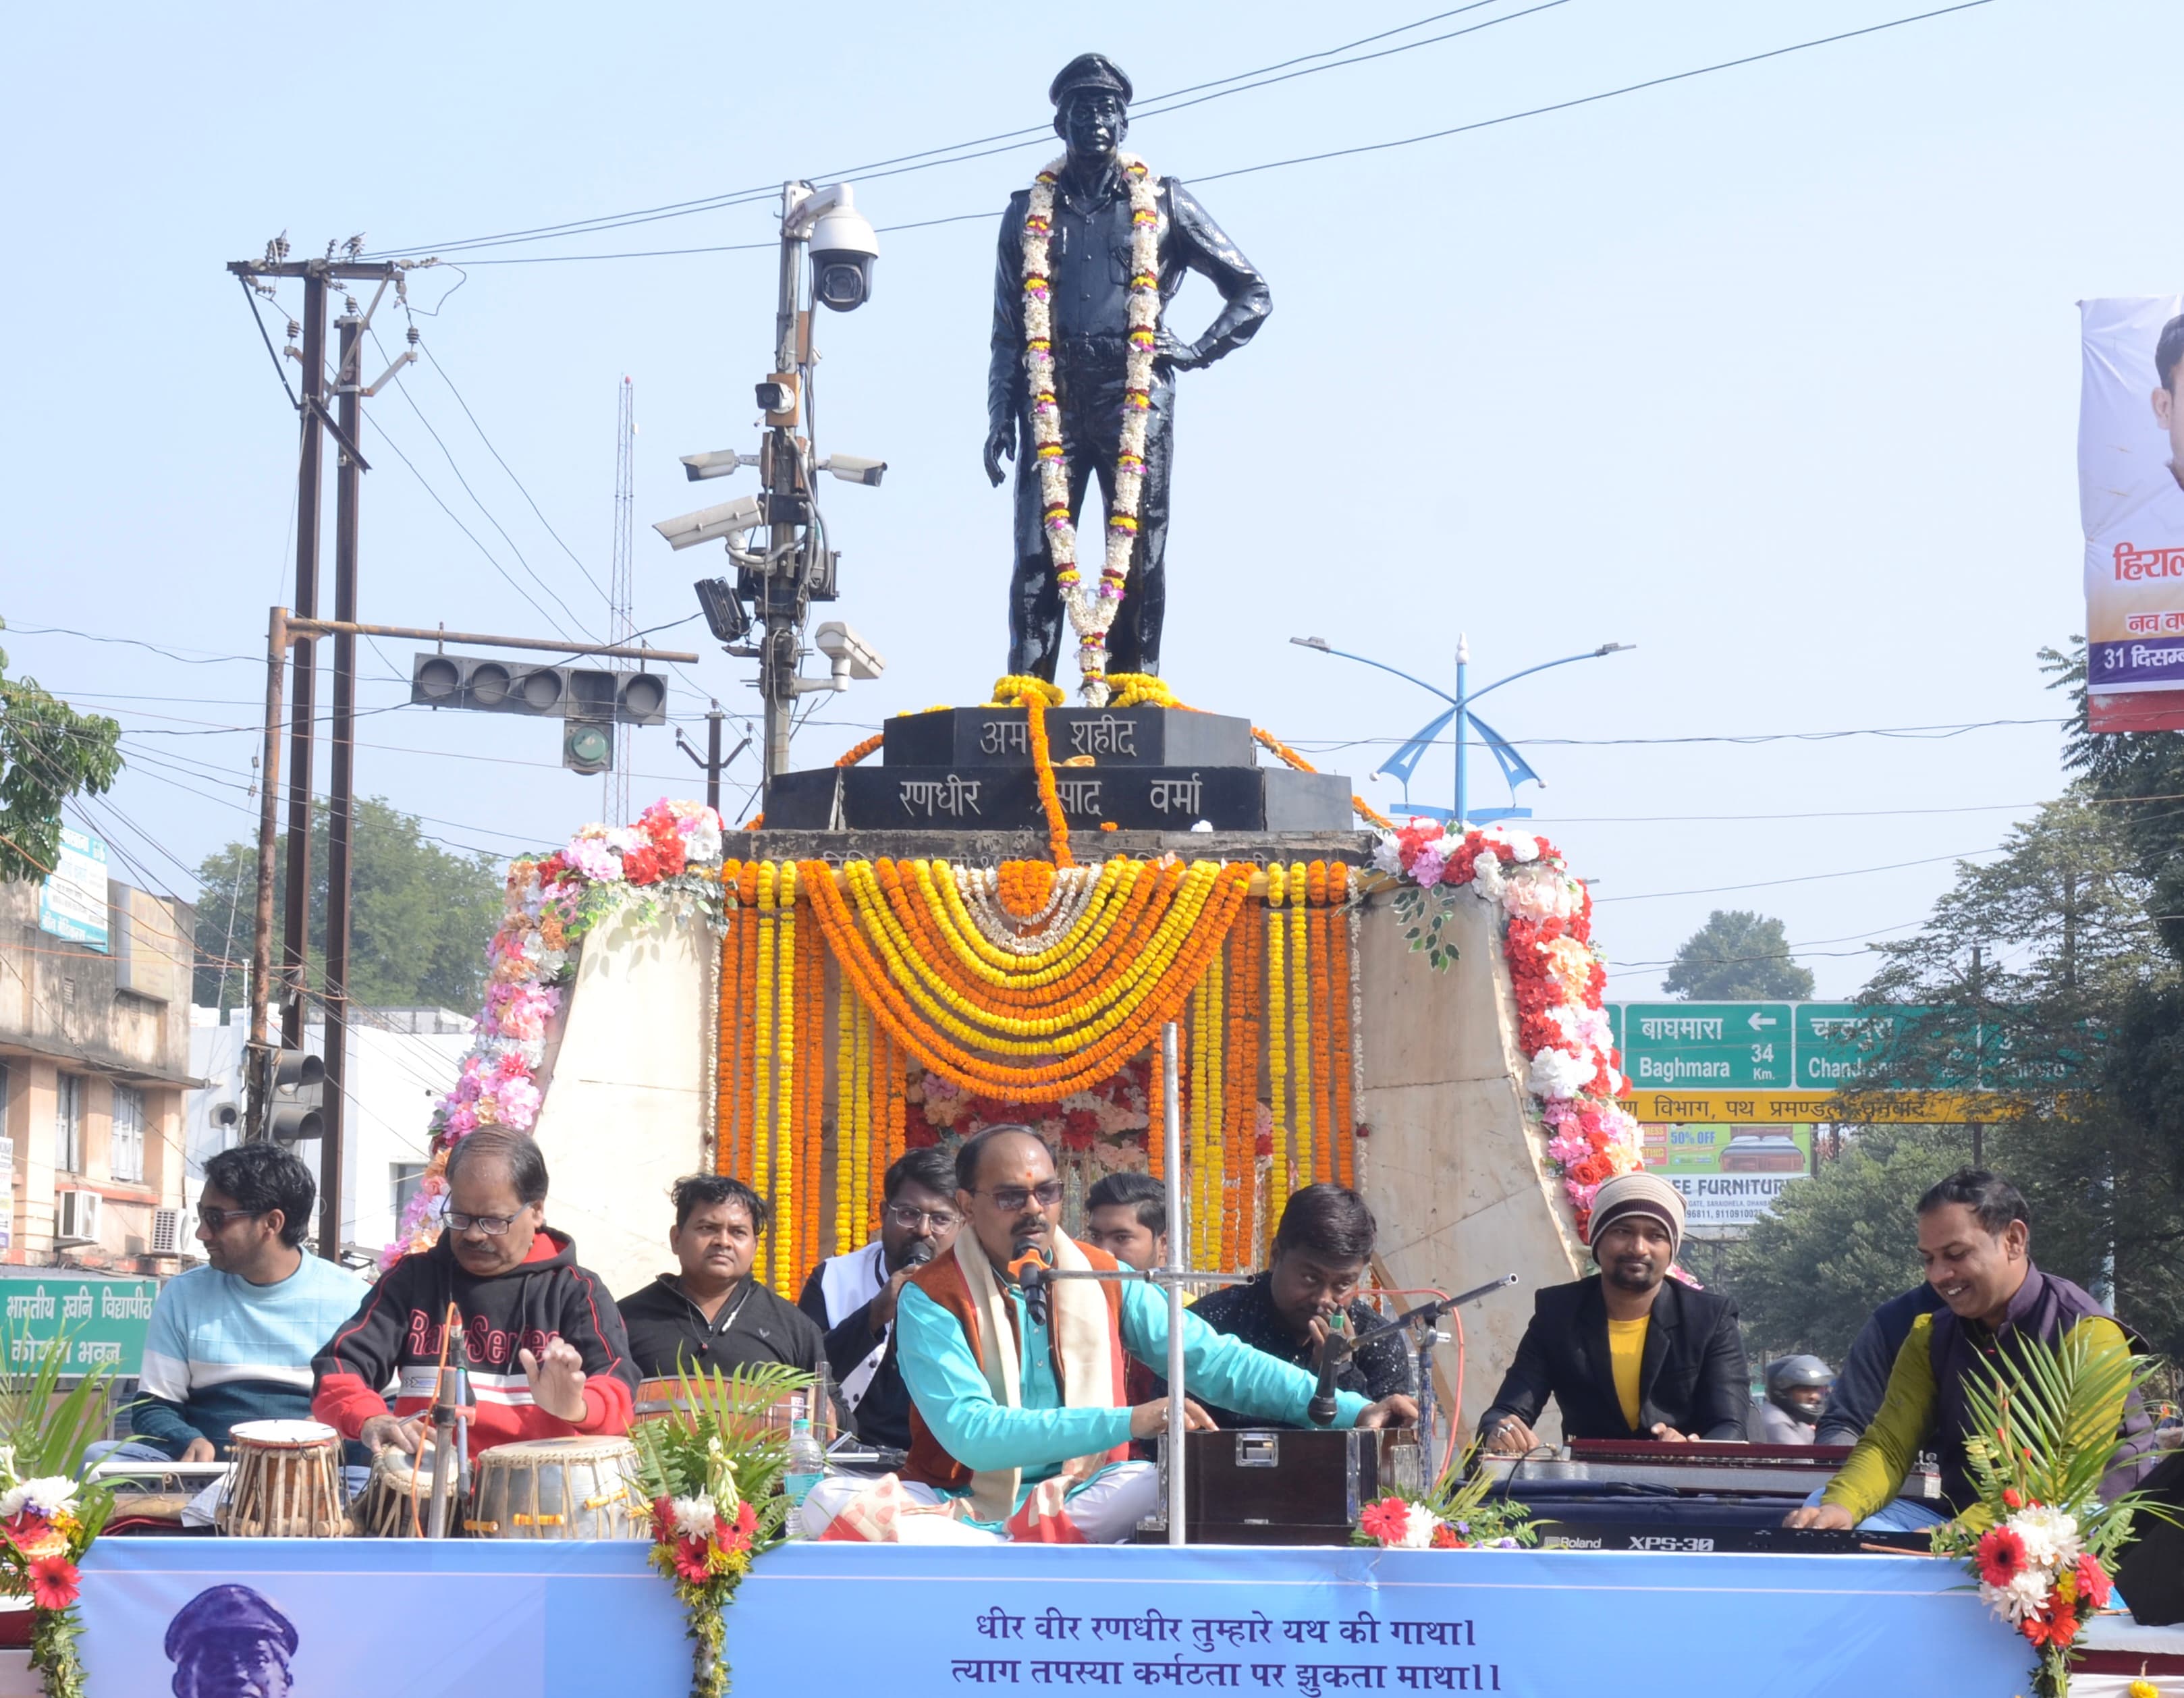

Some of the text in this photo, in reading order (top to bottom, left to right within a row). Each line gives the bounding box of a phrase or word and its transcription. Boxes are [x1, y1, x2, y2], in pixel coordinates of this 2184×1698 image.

[2129, 614, 2160, 632] नव
[2104, 647, 2124, 669] 31
[980, 714, 1137, 757] अम शहीद
[900, 774, 981, 816] रणधीर
[1150, 772, 1203, 815] वर्मा
[1640, 1018, 1723, 1040] बाघमारा
[1751, 1043, 1774, 1063] 34
[1639, 1057, 1730, 1082] Baghmara
[1753, 1068, 1775, 1080] Km.
[1726, 1101, 1755, 1117] पथ
[1670, 1131, 1716, 1145] 50% OFF
[1698, 1179, 1783, 1197] FURNITUR
[6, 1285, 55, 1319] भारतीय
[102, 1285, 153, 1319] विद्यापीठ
[1560, 1536, 1714, 1552] Roland XPS-30
[976, 1606, 1025, 1639] धीर
[1035, 1606, 1082, 1641] वीर
[1091, 1608, 1182, 1642] रणधीर
[1191, 1610, 1273, 1653] तुम्हारे
[1339, 1610, 1381, 1643] की
[951, 1660, 1021, 1683] त्याग
[1031, 1661, 1124, 1685] तपस्या
[1251, 1664, 1286, 1687] पर
[1295, 1664, 1388, 1698] झुकता
